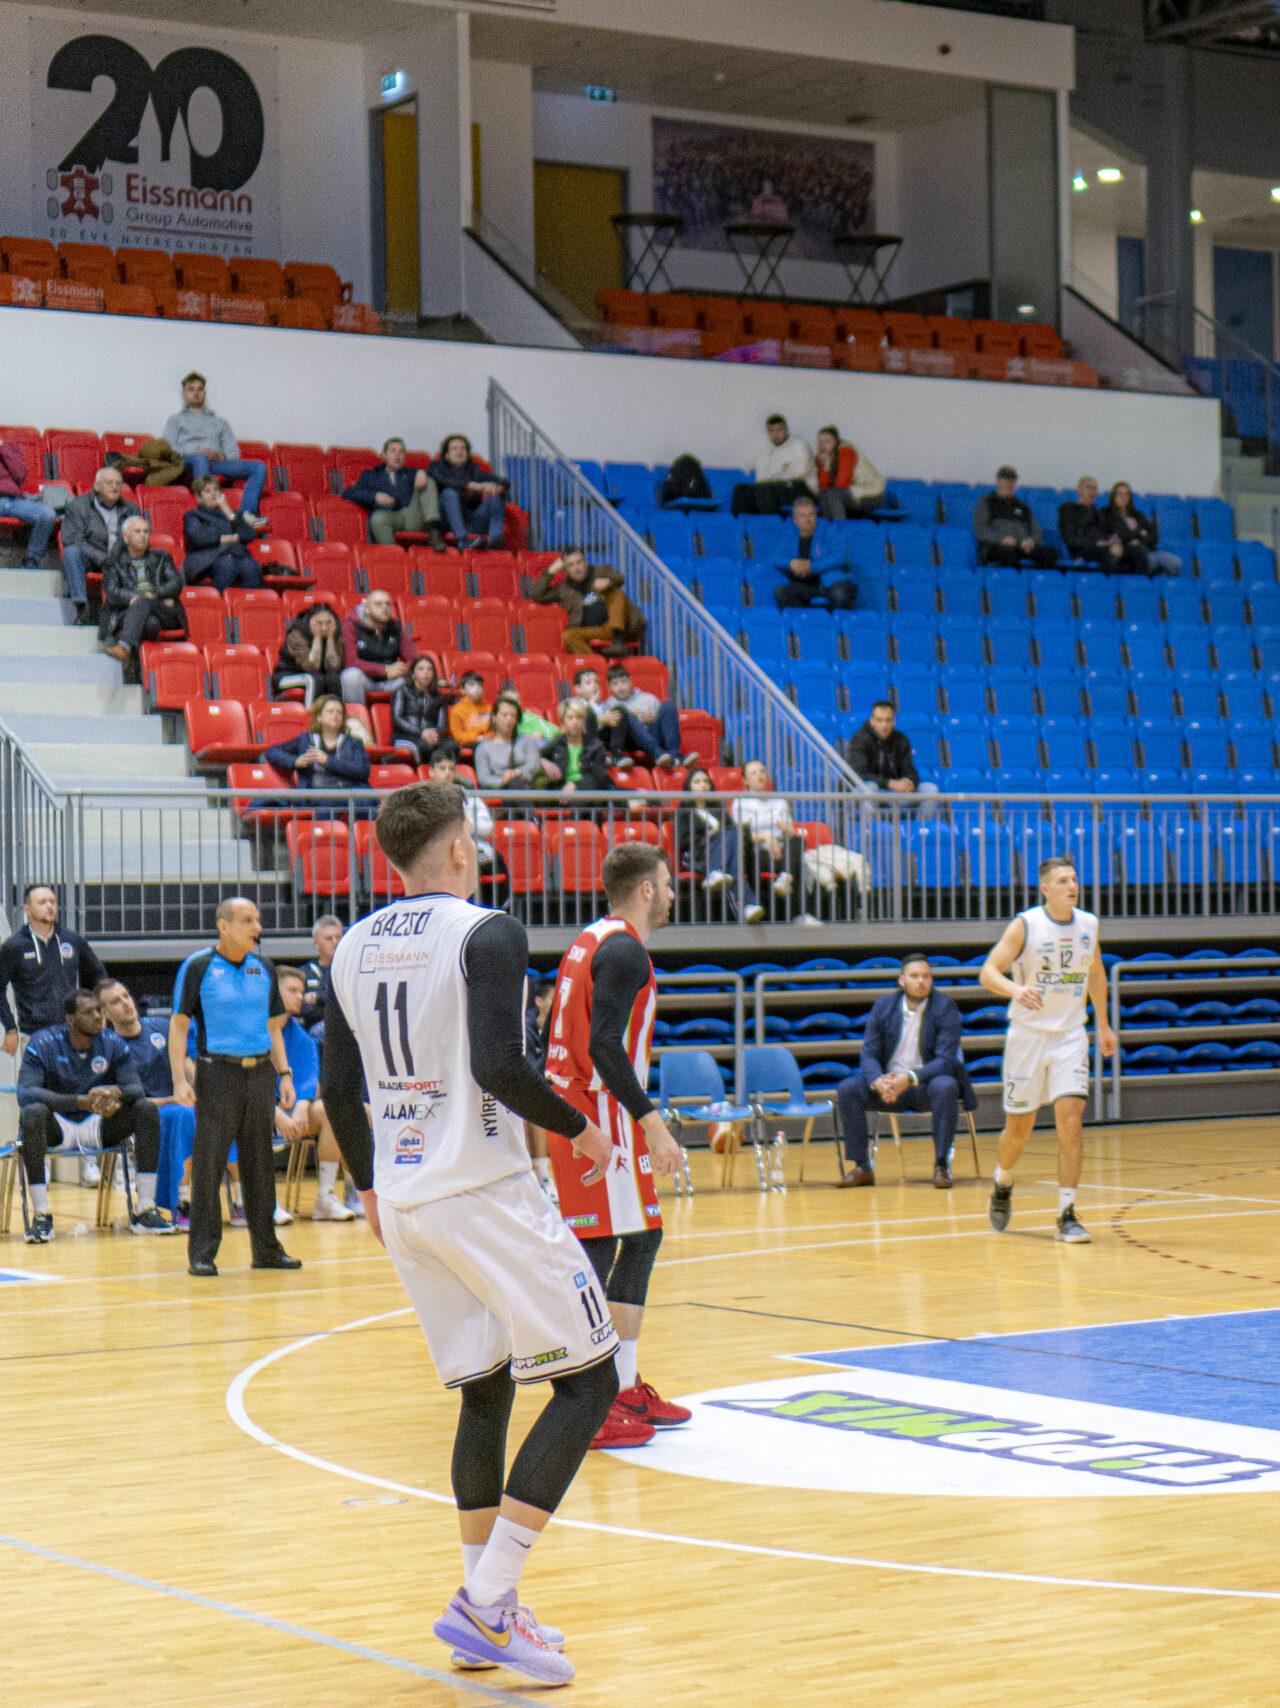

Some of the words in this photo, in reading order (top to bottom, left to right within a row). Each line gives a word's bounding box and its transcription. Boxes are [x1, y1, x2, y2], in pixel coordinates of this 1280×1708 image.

[47, 34, 265, 193] 20
[126, 173, 253, 213] Eissmann
[126, 206, 172, 226] Group
[177, 212, 253, 232] Automotive
[1060, 950, 1073, 968] 12
[374, 981, 415, 1077] 11
[378, 1080, 440, 1091] BLADESPORT
[383, 1103, 436, 1120] ALANEX
[581, 1285, 604, 1329] 11
